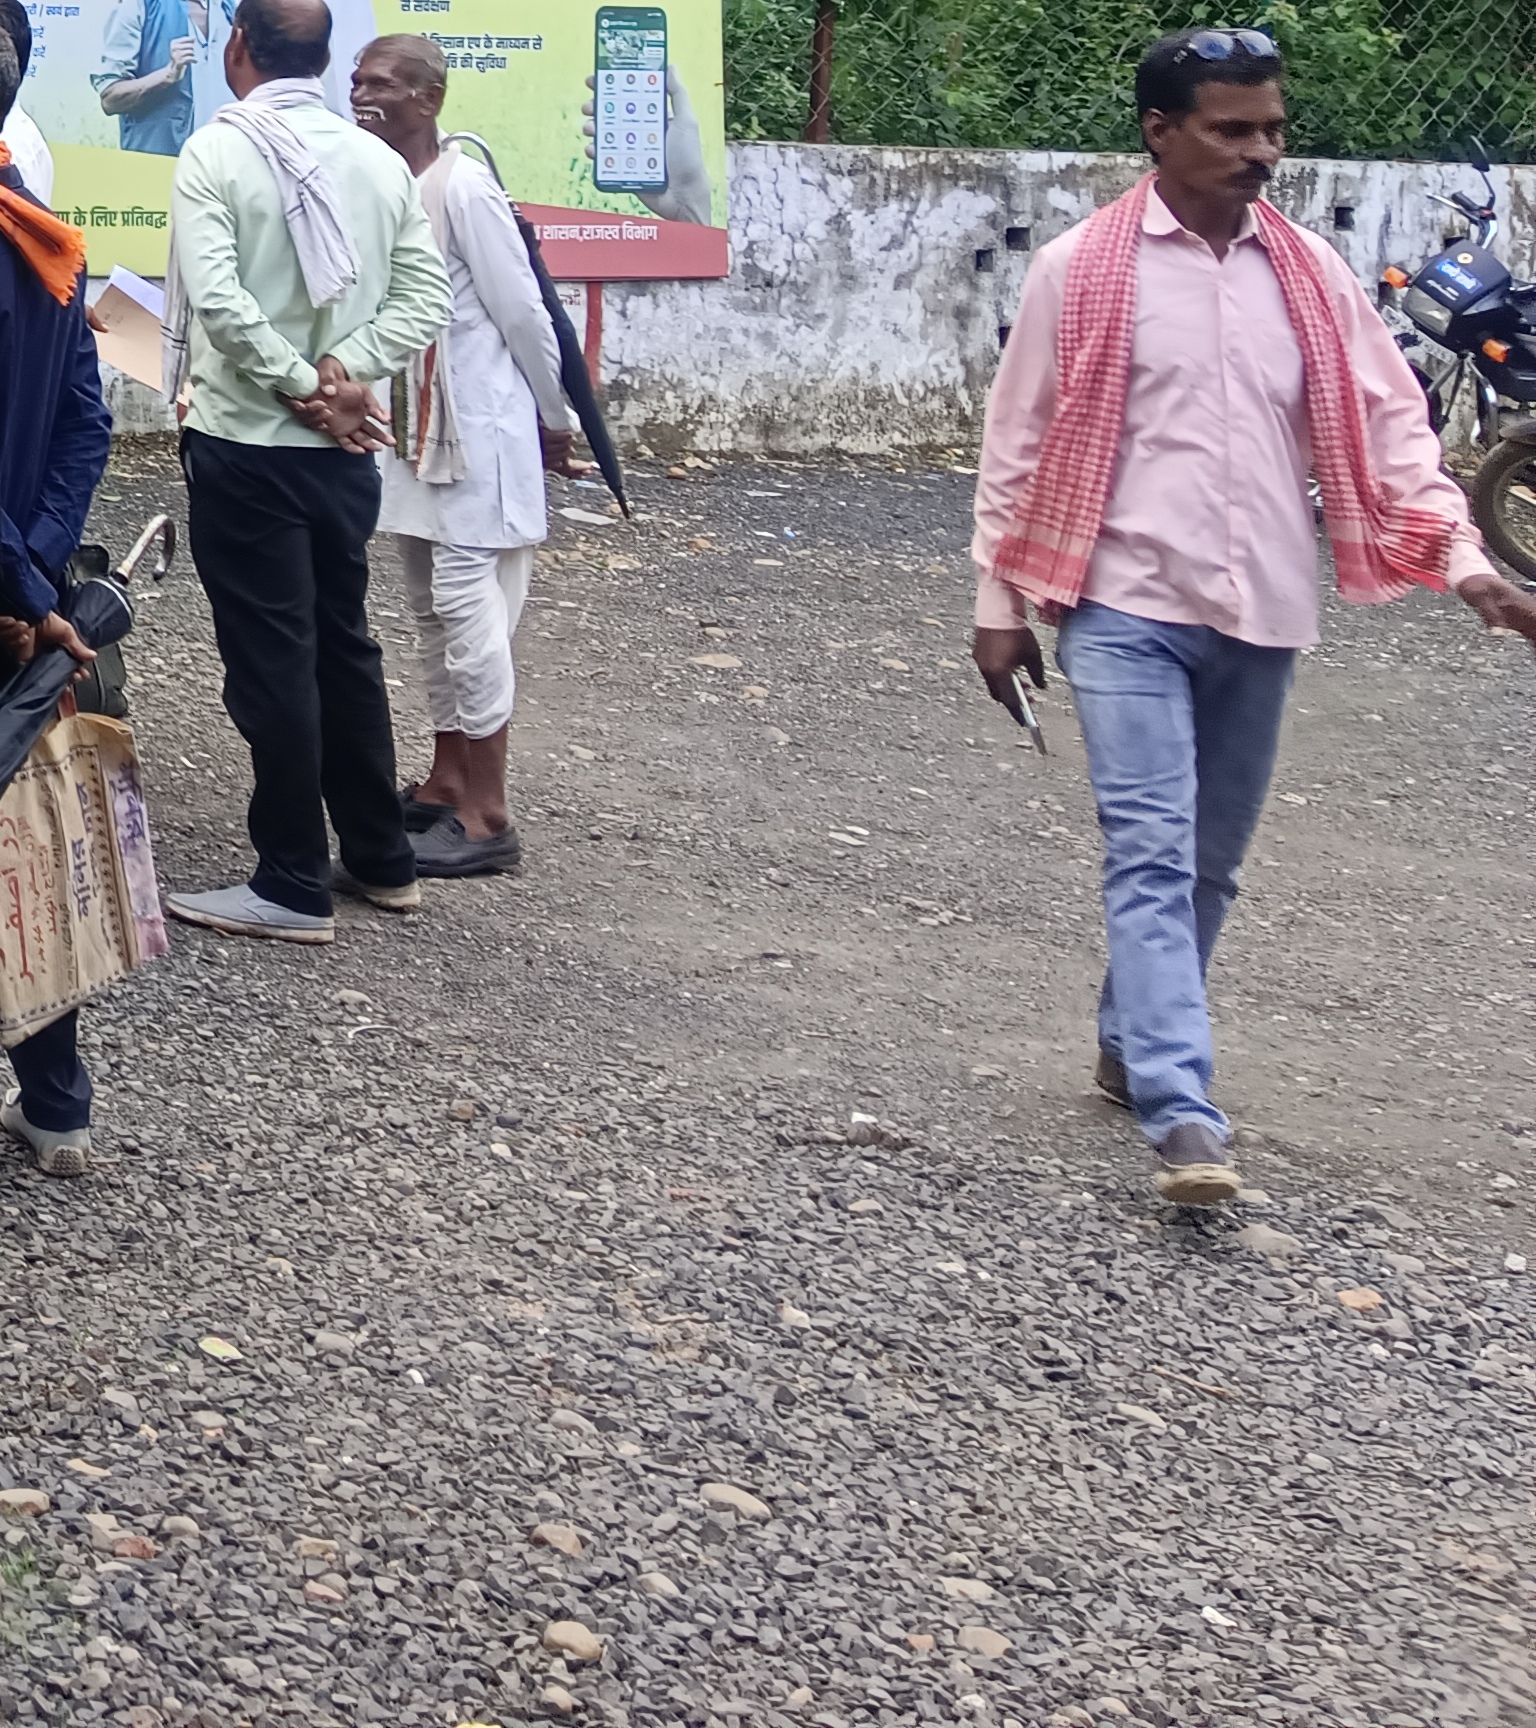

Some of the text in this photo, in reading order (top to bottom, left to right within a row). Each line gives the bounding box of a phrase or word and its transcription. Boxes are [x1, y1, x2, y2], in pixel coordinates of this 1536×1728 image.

[483, 34, 493, 49] के
[532, 34, 543, 51] से
[73, 206, 87, 227] के
[90, 206, 118, 227] लिए
[121, 206, 168, 229] प्रतिबद्ध
[622, 221, 657, 240] विभाग
